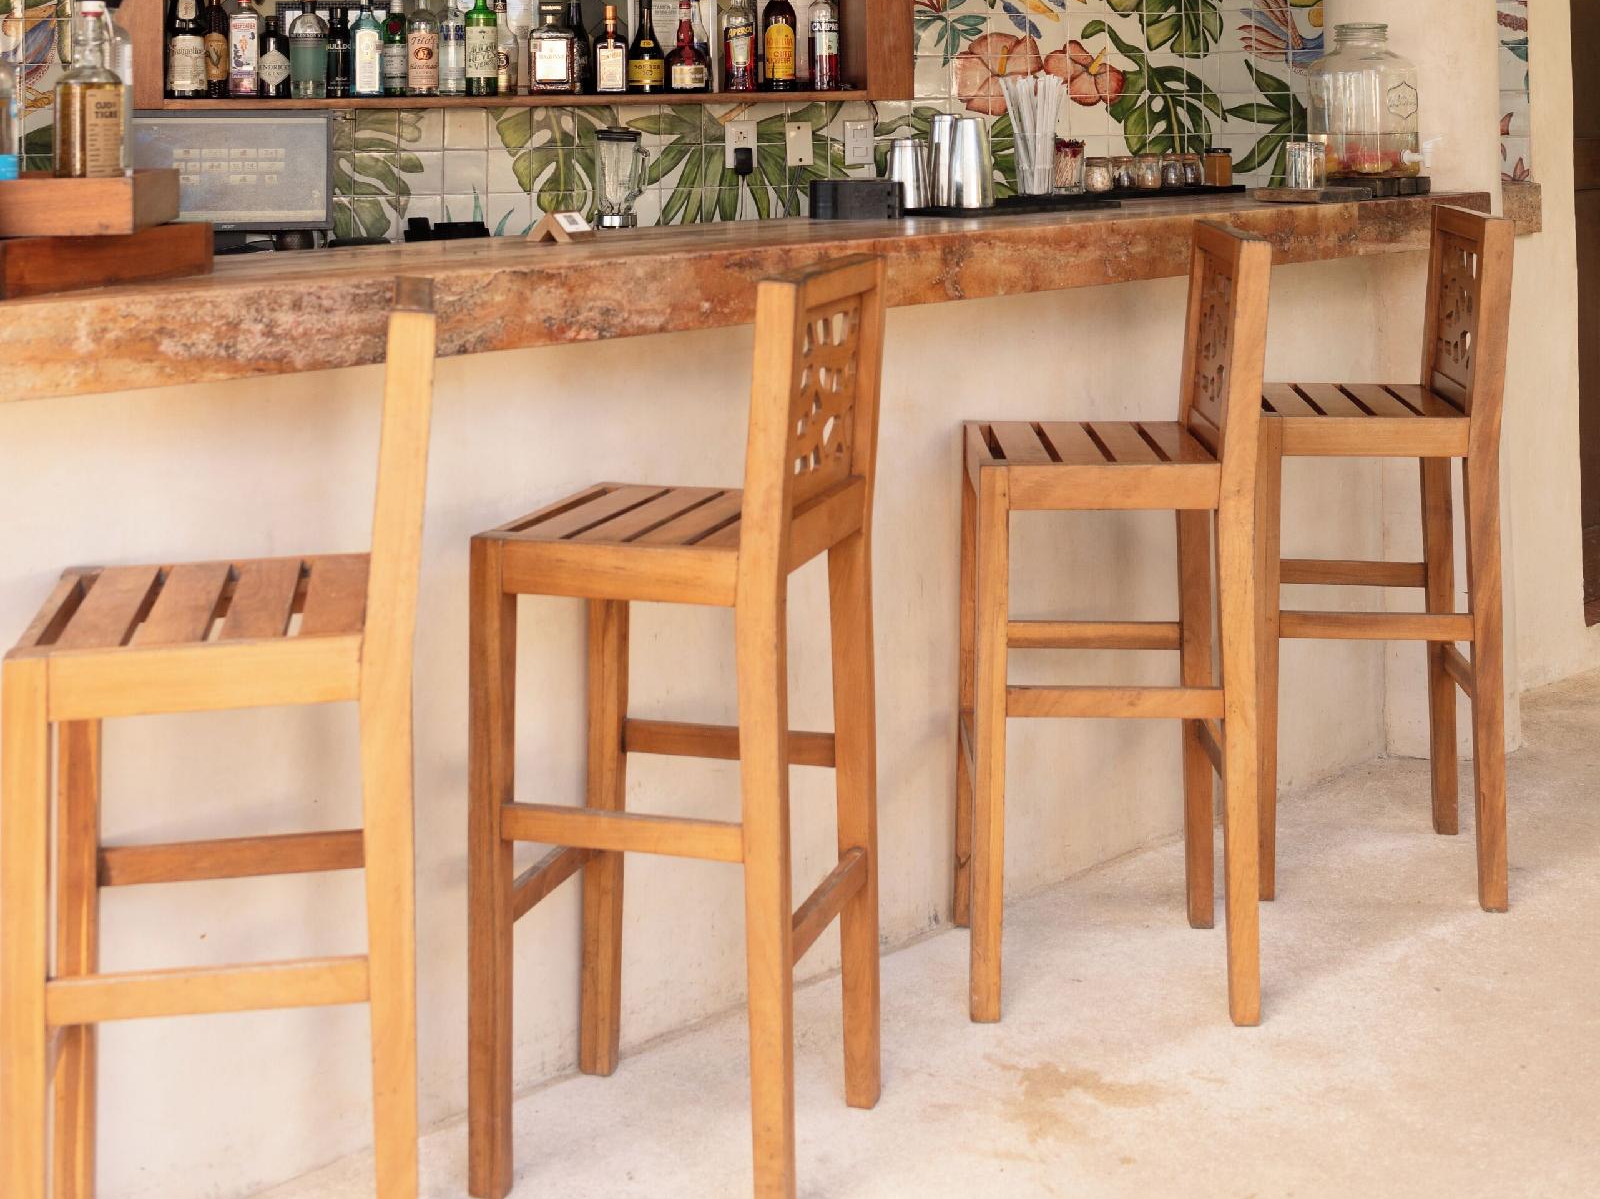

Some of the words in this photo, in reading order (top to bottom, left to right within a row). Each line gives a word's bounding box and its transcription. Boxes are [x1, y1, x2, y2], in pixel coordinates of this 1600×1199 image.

[440, 24, 464, 33] ABOL
[728, 25, 752, 36] APEROL
[812, 22, 839, 31] CAMPAR
[411, 35, 436, 45] Tito's
